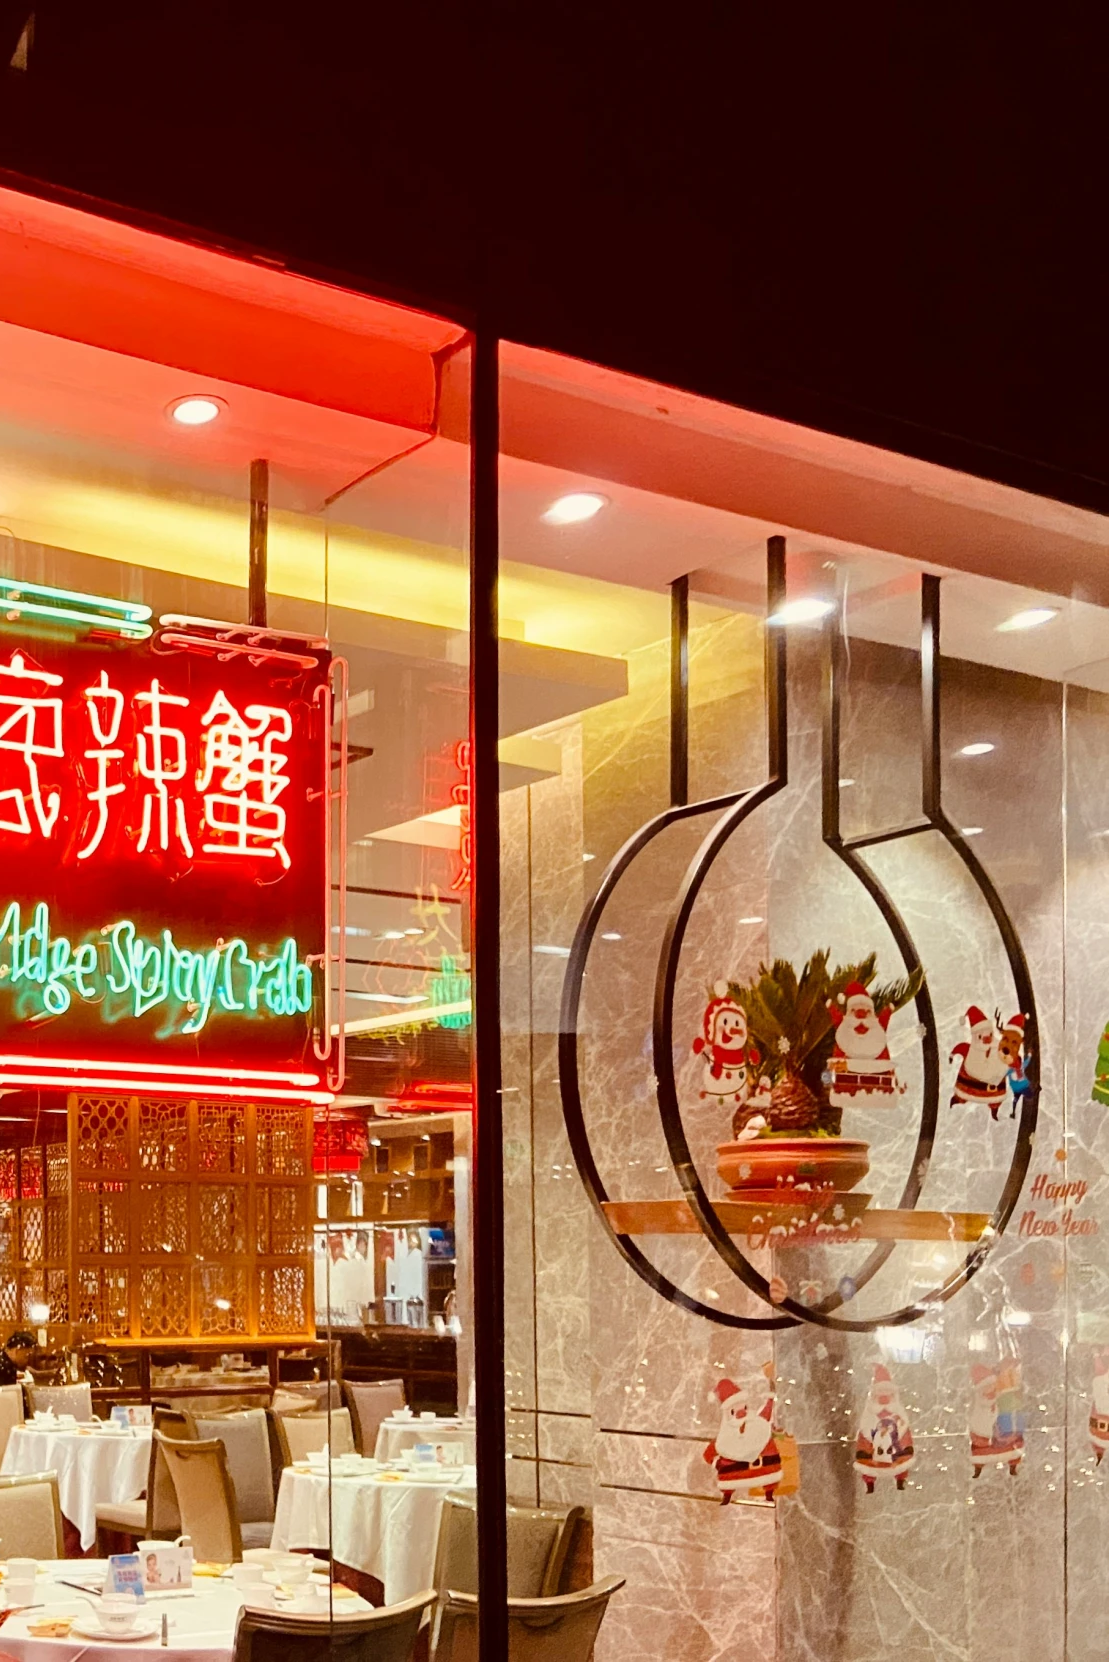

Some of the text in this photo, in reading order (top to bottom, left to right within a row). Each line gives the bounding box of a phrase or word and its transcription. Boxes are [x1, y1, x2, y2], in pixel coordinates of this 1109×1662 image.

[217, 937, 313, 1016] Crab
[1030, 1173, 1088, 1207] Happy
[1019, 1208, 1099, 1237] New Year
